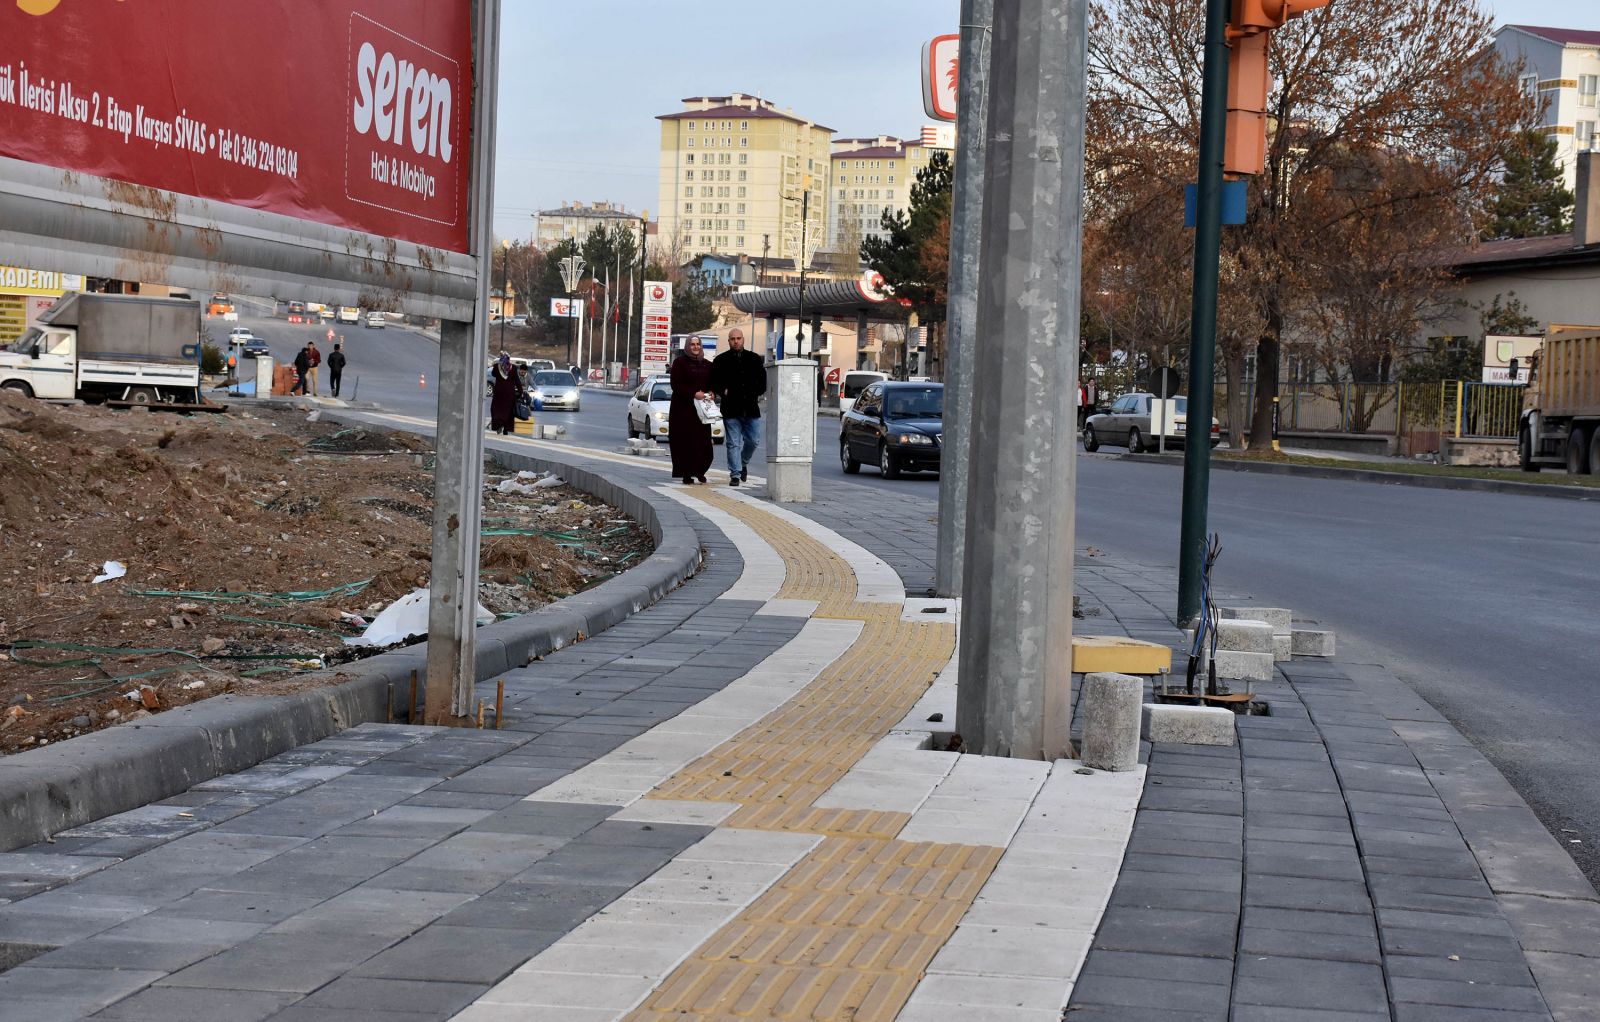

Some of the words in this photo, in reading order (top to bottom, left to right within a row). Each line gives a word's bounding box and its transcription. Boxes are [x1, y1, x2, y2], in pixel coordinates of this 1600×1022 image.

[20, 60, 55, 114] İlerisi
[58, 81, 88, 123] Aksu
[92, 91, 104, 128] 2.
[107, 96, 132, 144] Etap
[135, 104, 173, 150] Karşısı
[175, 108, 207, 155] SİVAS
[233, 133, 240, 164] 0
[240, 135, 257, 169] 346
[258, 140, 275, 173] 224
[275, 146, 287, 177] 03
[287, 149, 298, 179] 04
[354, 42, 452, 163] seren
[390, 157, 398, 187] &
[399, 160, 435, 200] Mobilya
